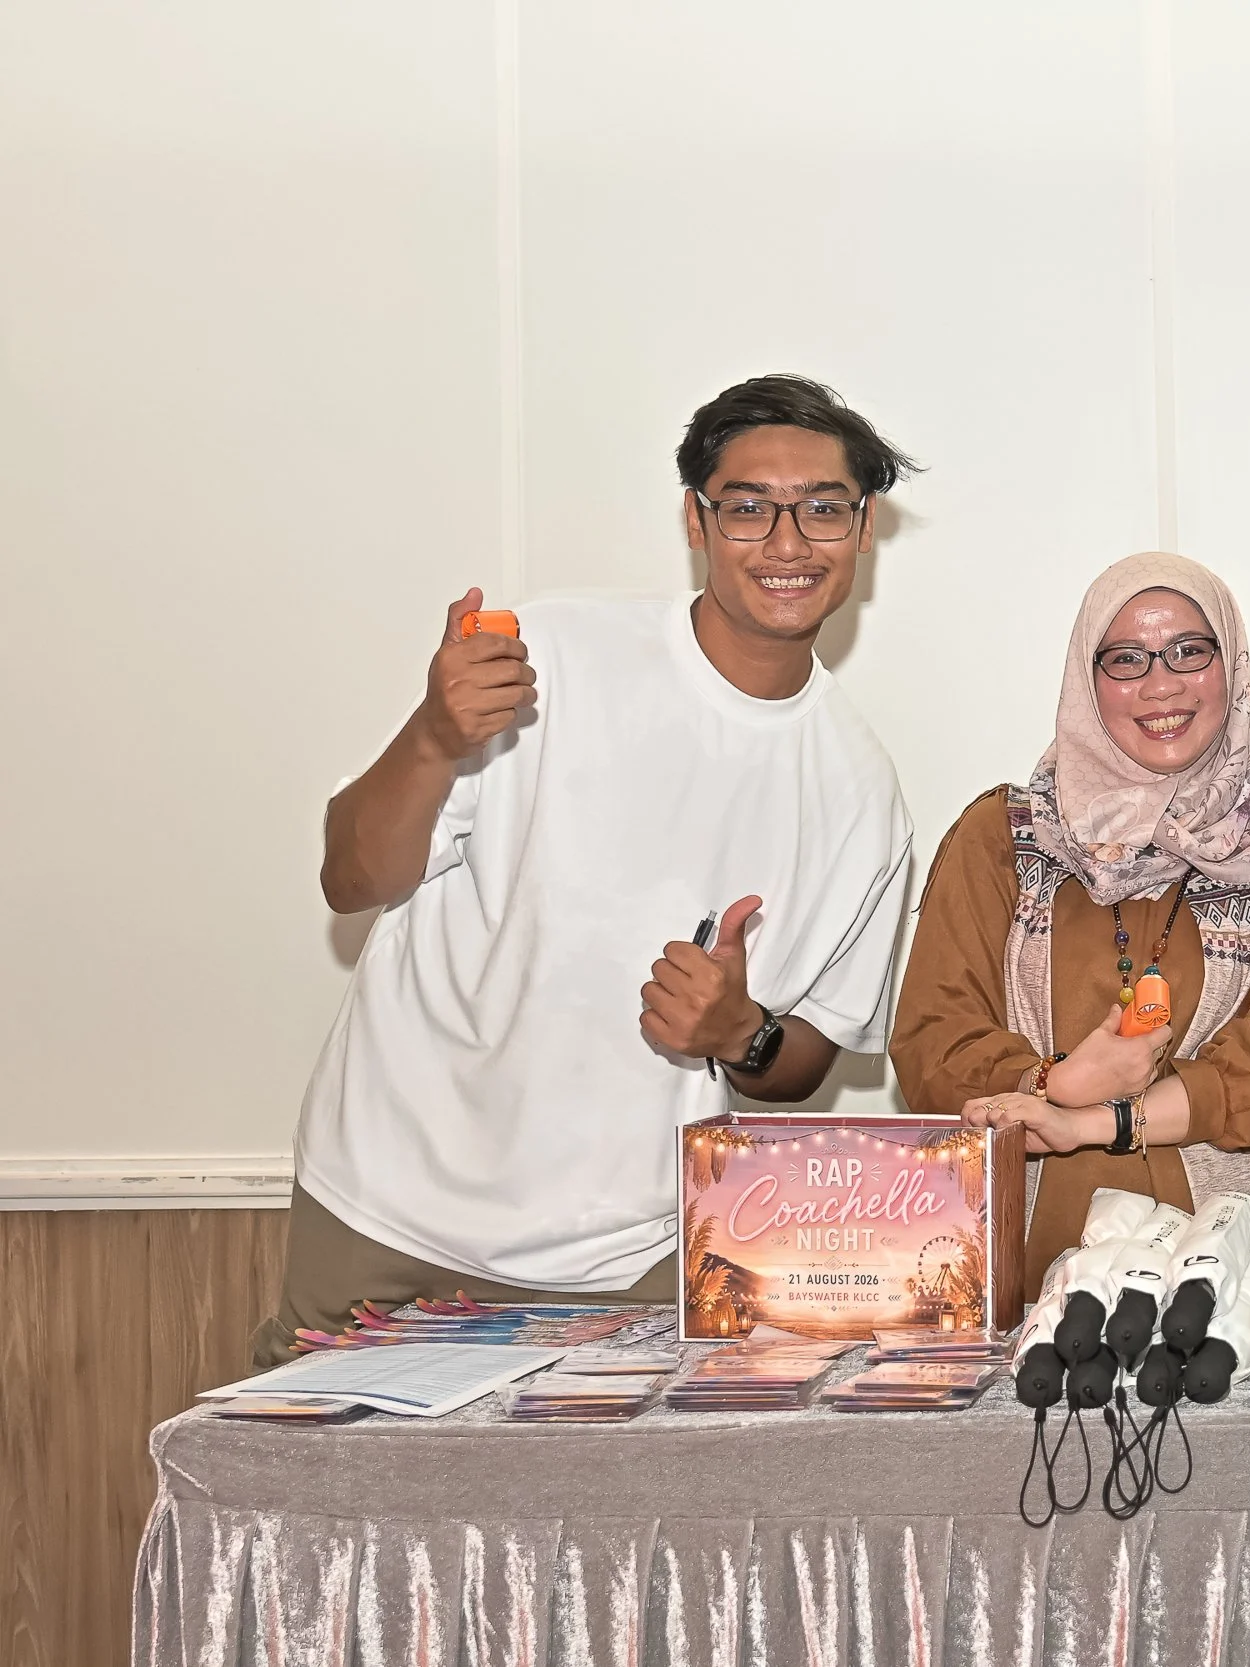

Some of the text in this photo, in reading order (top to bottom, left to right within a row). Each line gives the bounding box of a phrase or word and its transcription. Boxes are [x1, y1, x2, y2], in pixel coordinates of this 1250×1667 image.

[806, 1158, 863, 1187] RAP
[728, 1168, 946, 1242] Coachella
[796, 1228, 875, 1251] NIGHT
[788, 1274, 879, 1285] 21 AUGUST 2026
[788, 1292, 880, 1302] BAYSWATER KLCC
